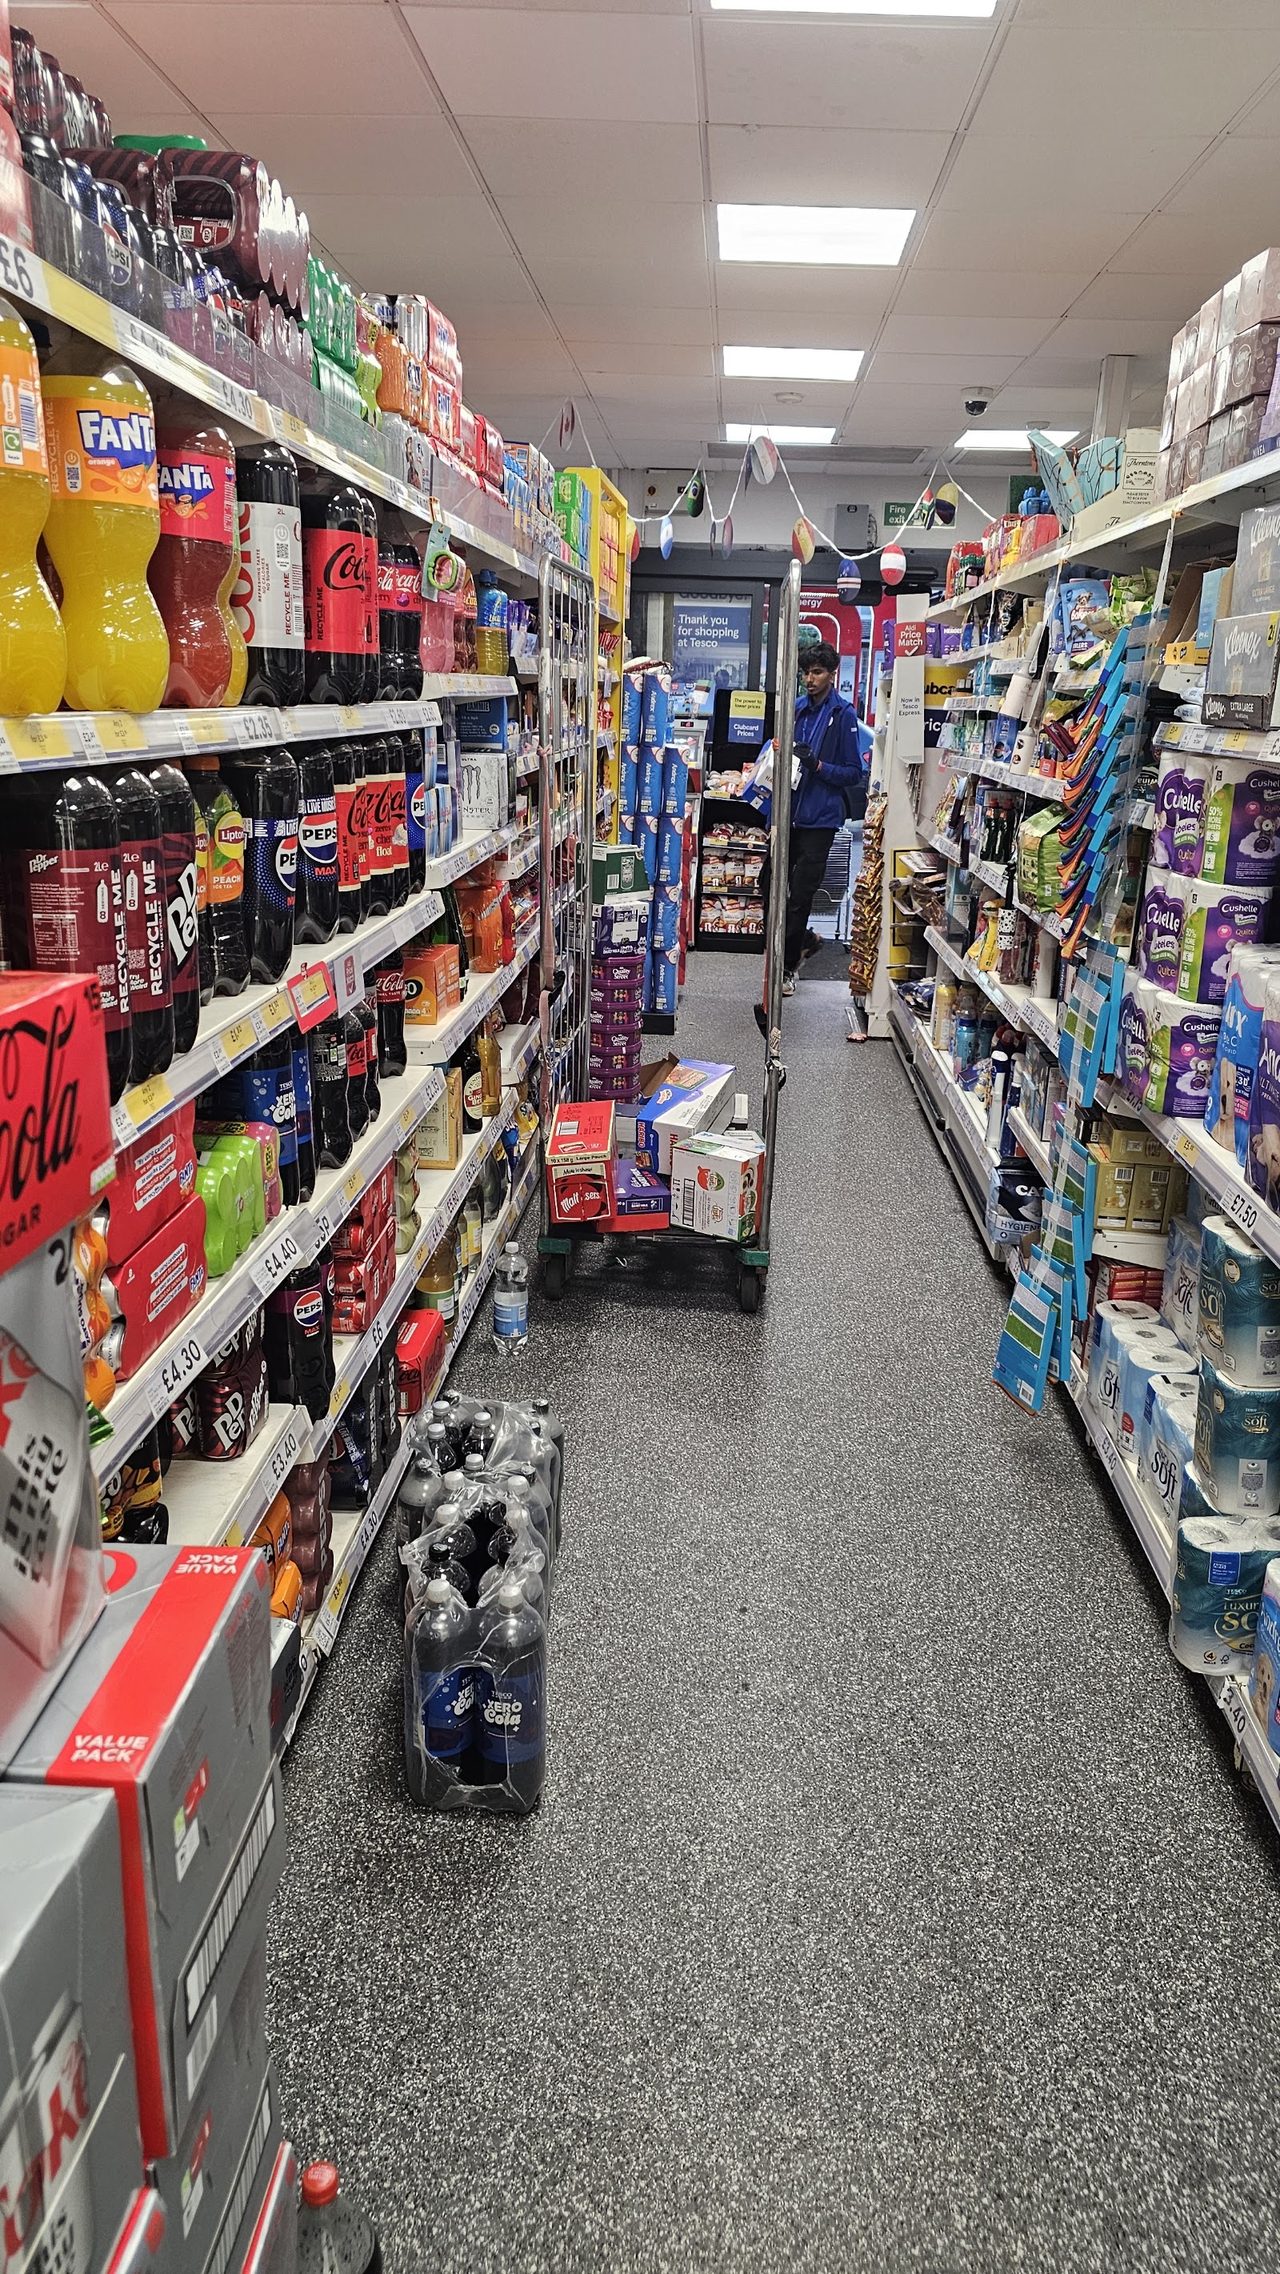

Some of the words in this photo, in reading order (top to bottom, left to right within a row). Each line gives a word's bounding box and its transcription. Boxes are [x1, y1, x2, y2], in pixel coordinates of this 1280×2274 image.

[222, 381, 253, 420] £4.30
[88, 458, 115, 466] orange
[1127, 457, 1156, 467] Thorntons
[889, 505, 907, 514] Fire
[888, 515, 905, 524] exit
[283, 572, 290, 591] ME
[317, 586, 324, 602] ME
[284, 591, 292, 635] RECYCLE
[679, 614, 708, 625] Thank
[710, 616, 729, 628] you
[904, 624, 917, 632] Aldi
[678, 626, 692, 636] for
[694, 627, 739, 640] shopping
[900, 631, 922, 641] Price
[677, 638, 687, 647] at
[690, 637, 718, 648] Tesco
[898, 638, 923, 648] Match
[1224, 625, 1262, 667] Kleenex
[649, 690, 657, 713] Andrex
[744, 698, 757, 706] power
[747, 703, 761, 711] prices
[1230, 702, 1242, 711] EXTRA
[1242, 702, 1254, 712] LARGE
[1205, 697, 1227, 721] Kleenex
[243, 715, 273, 739] £2.35
[733, 723, 759, 731] Clubcard
[737, 730, 754, 738] Prices
[644, 763, 652, 785] Andrex
[670, 763, 678, 785] Andrex
[1208, 806, 1223, 816] 50%
[343, 836, 348, 849] ME
[376, 846, 393, 857] float
[29, 855, 58, 873] Pepper
[35, 854, 47, 864] Dr
[142, 859, 157, 895] ME
[315, 867, 336, 876] MAX
[213, 876, 241, 884] PEACH
[110, 869, 122, 906] ME
[1221, 903, 1258, 914] Cushelle
[146, 899, 164, 996] RECYCLE
[114, 911, 130, 1013] RECYCLE
[1183, 1021, 1219, 1032] Cushelle
[638, 1121, 646, 1148] HARIBO
[1231, 1194, 1257, 1229] £7.50
[264, 1237, 297, 1279] £4.40
[304, 1325, 320, 1335] MAX
[373, 1321, 384, 1345] £6
[161, 1339, 201, 1394] £4.30
[271, 1433, 297, 1481] £3.40
[1101, 1434, 1117, 1470] £3.40
[360, 1510, 378, 1549] £4.30
[187, 1553, 238, 1564] PACK
[175, 1562, 237, 1574] VALUE
[1207, 1652, 1215, 1660] 4
[488, 1699, 523, 1714] XERO
[483, 1708, 522, 1726] Cola
[74, 1734, 149, 1749] VALUE
[70, 1749, 138, 1763] PACK
